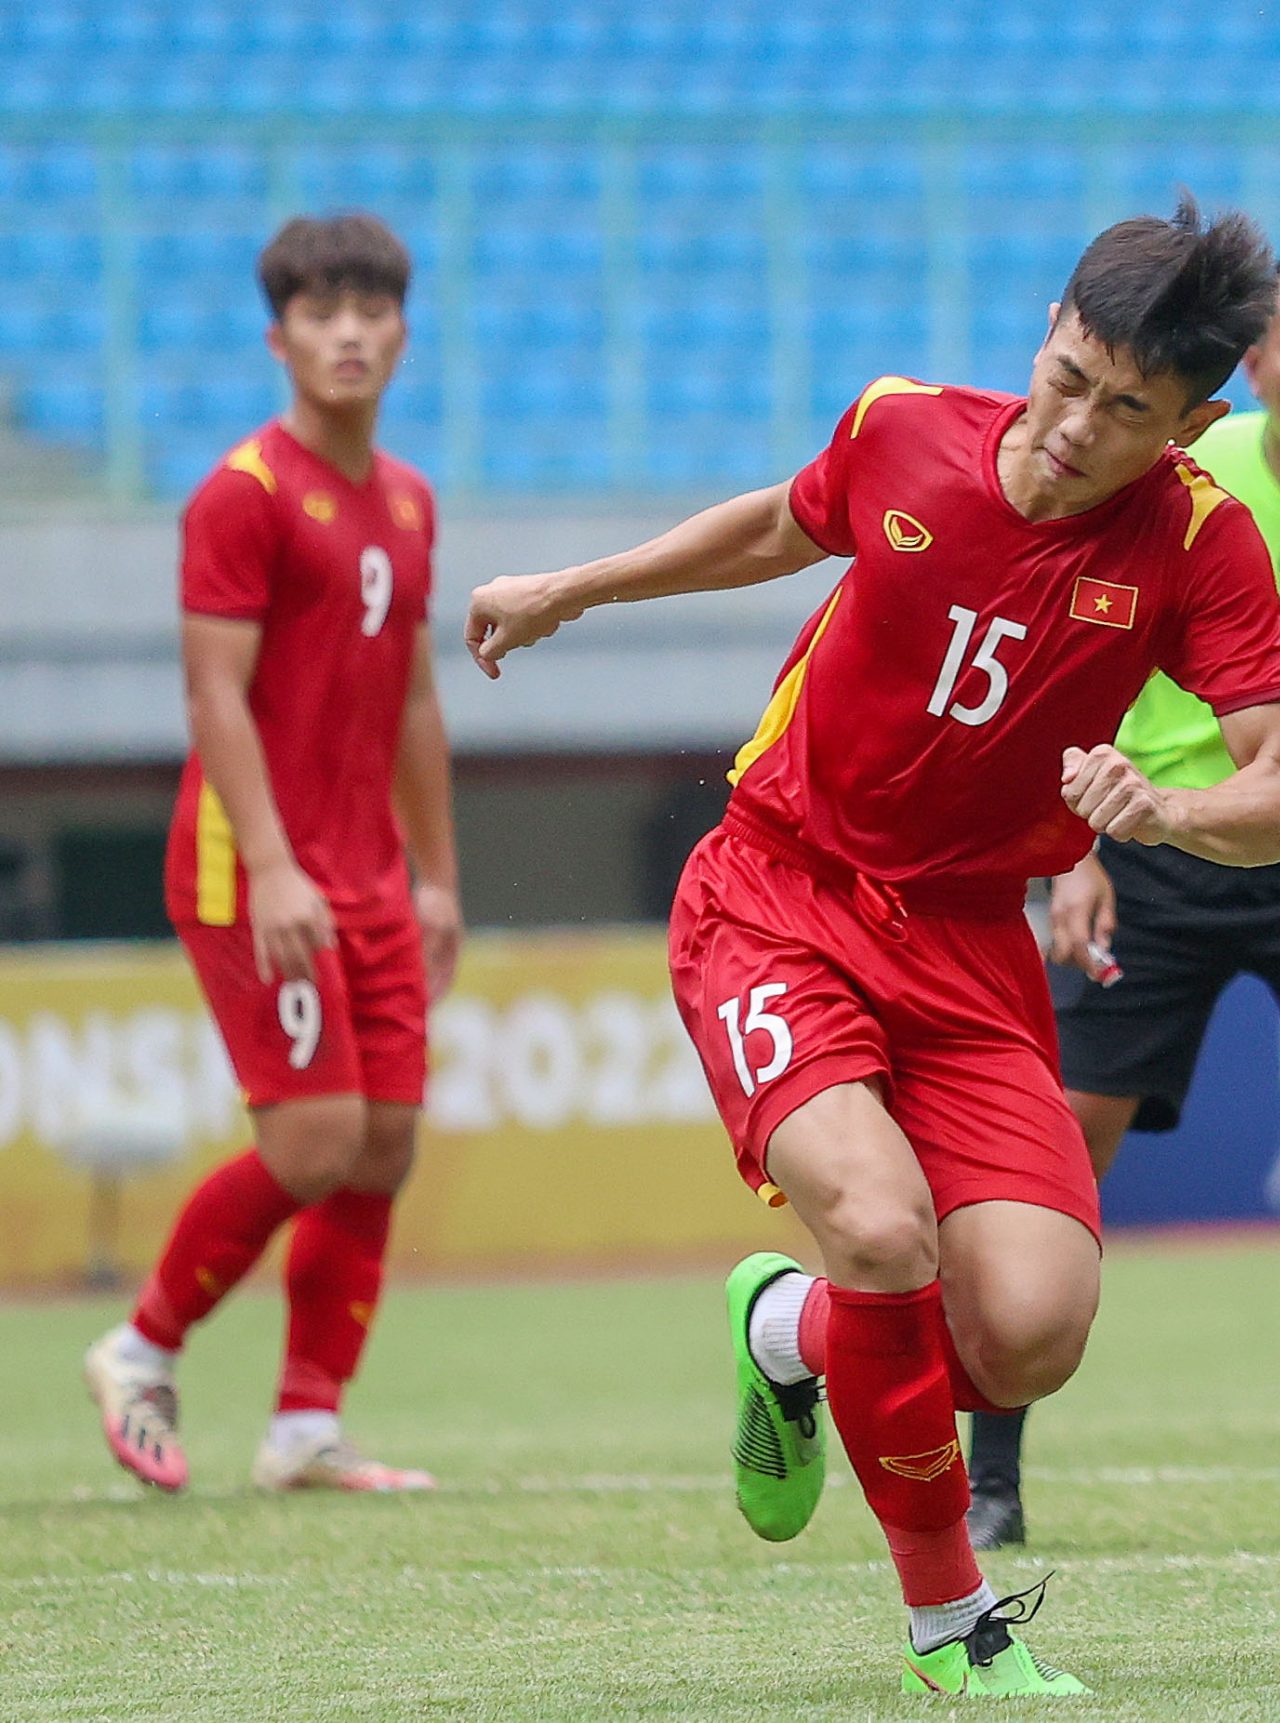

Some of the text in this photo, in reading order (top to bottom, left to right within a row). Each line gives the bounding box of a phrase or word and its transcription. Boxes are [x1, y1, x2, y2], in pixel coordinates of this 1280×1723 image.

[359, 545, 393, 637] 9
[926, 604, 1027, 726] 15
[277, 979, 323, 1069] 9
[717, 982, 793, 1098] 15
